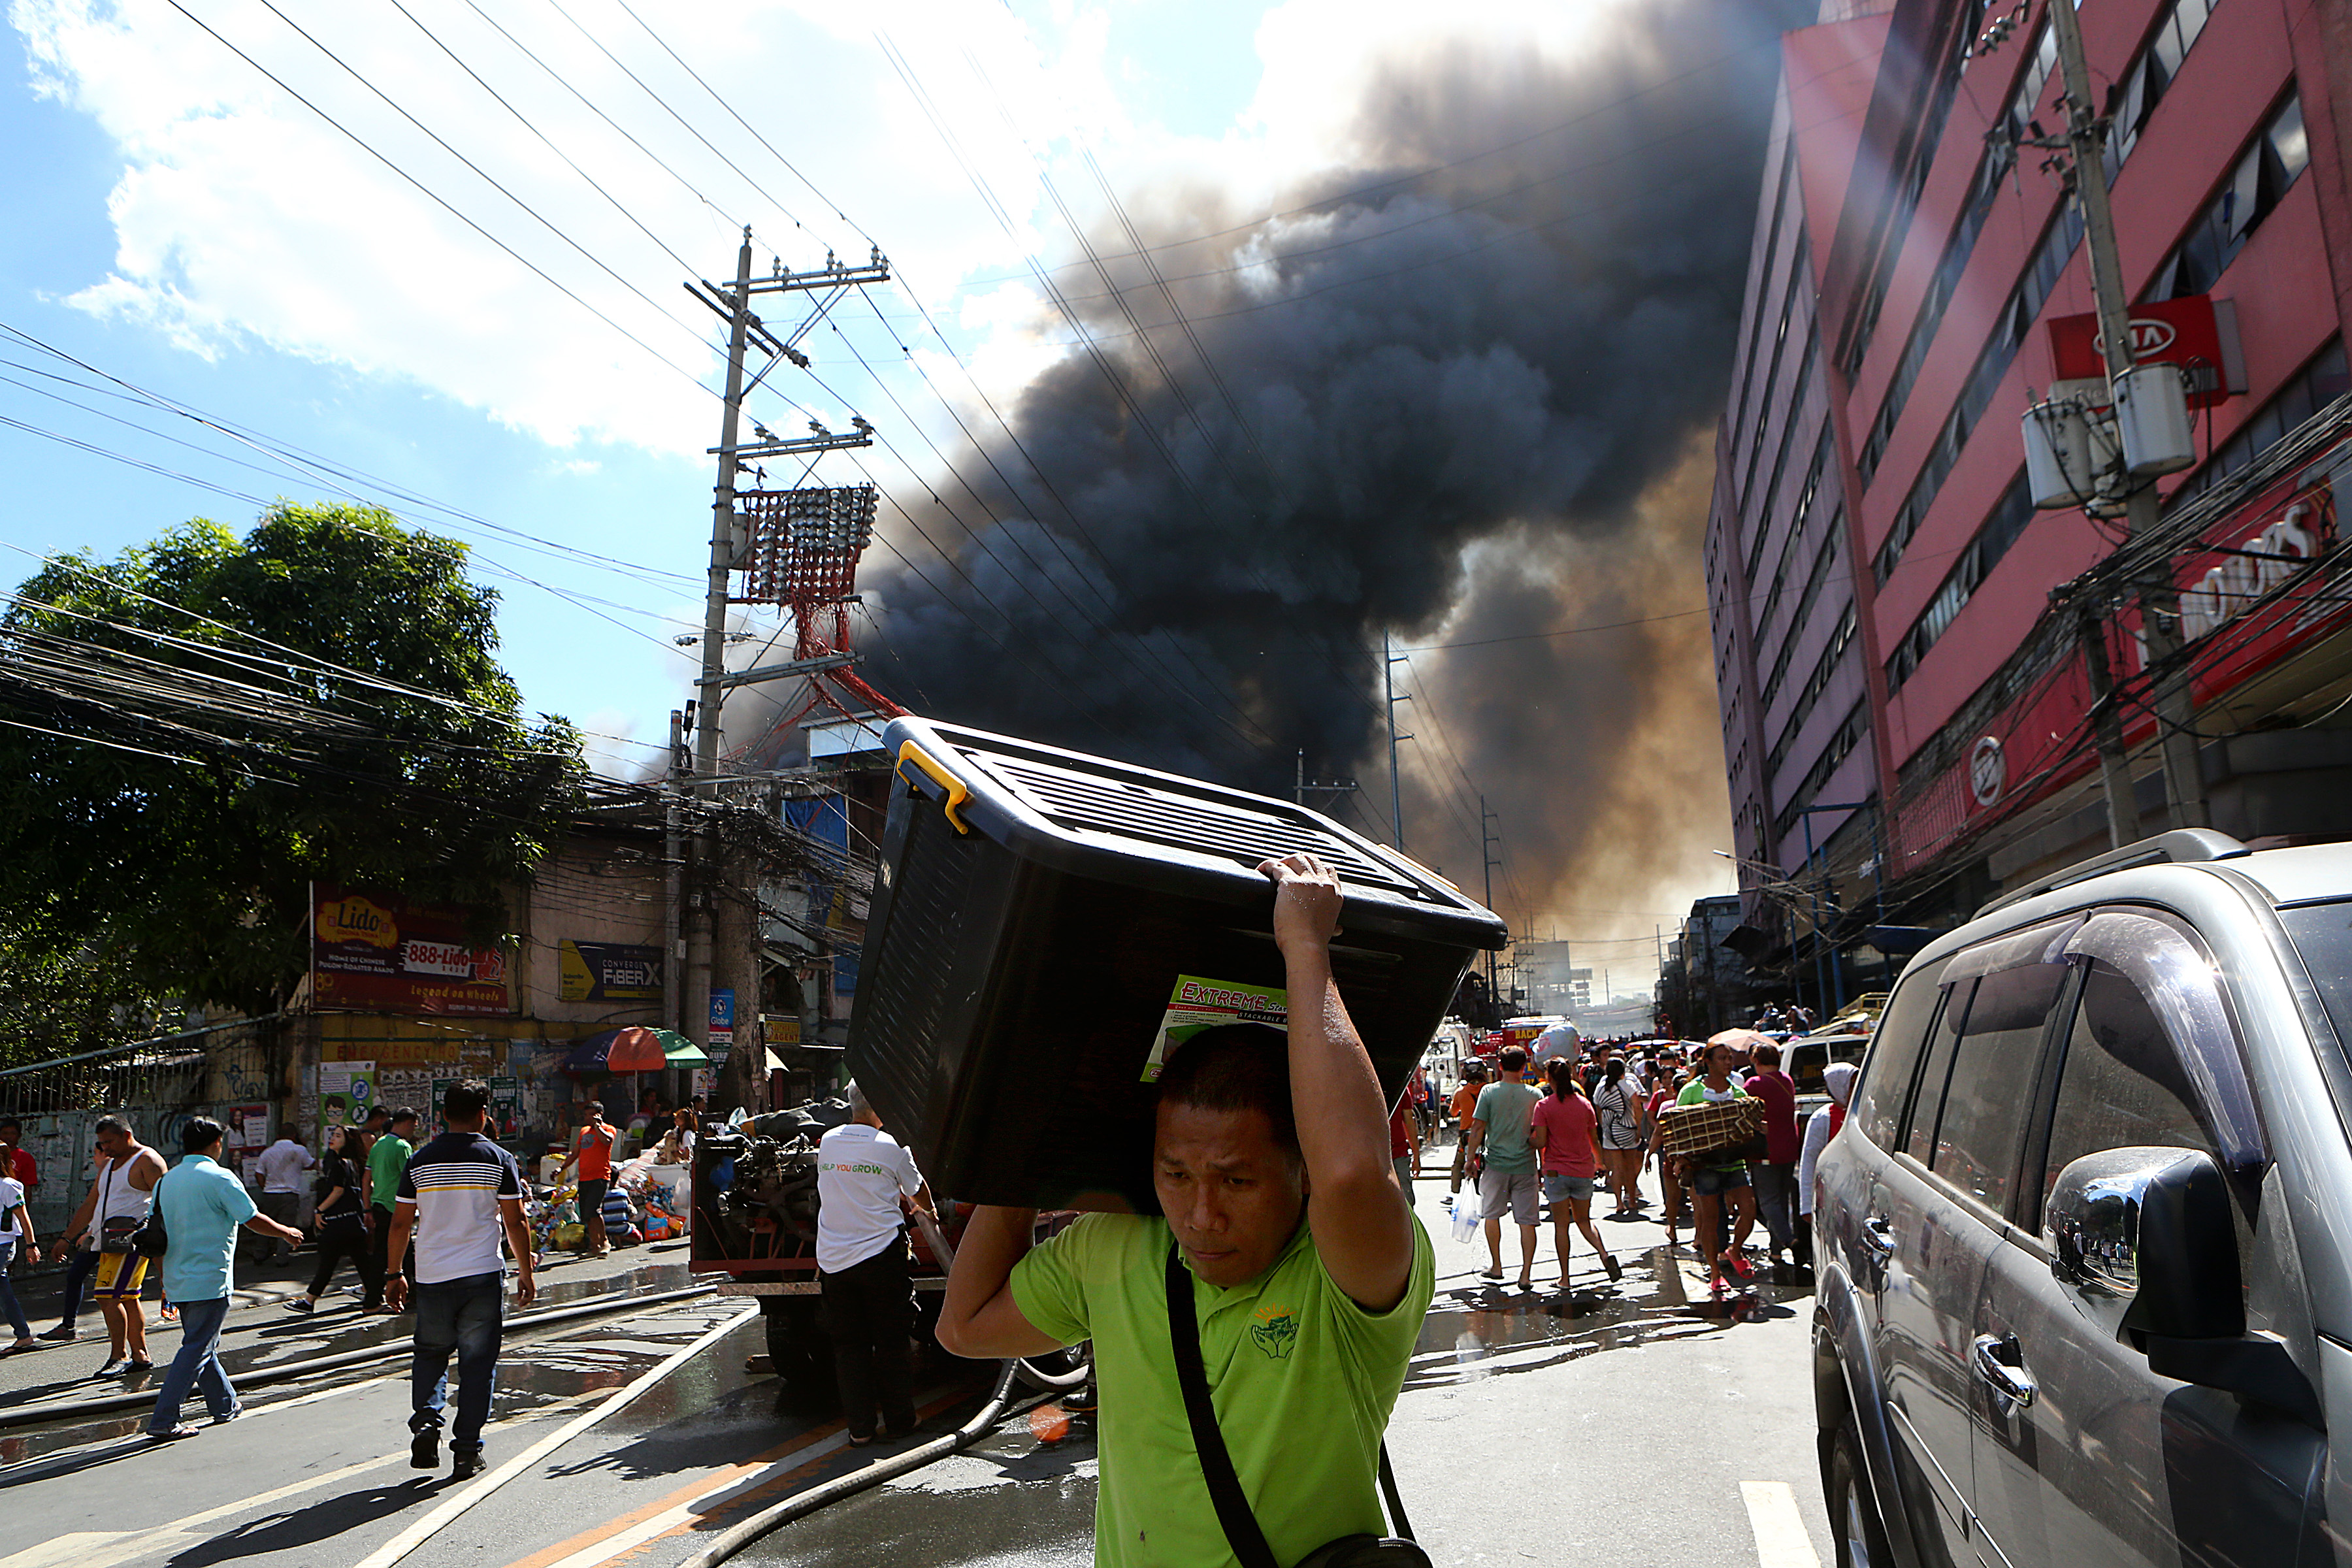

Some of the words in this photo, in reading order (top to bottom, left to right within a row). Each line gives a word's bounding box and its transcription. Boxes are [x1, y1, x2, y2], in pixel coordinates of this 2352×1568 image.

[338, 903, 380, 932] Lido
[329, 954, 348, 962] HOME
[359, 956, 385, 966] CHINESE
[408, 944, 469, 967] 888-Lido
[602, 959, 643, 970] CONVERGE
[410, 985, 449, 1001] Legend
[451, 989, 464, 998] on
[1267, 1002, 1287, 1012] Stor
[710, 1016, 729, 1025] Globe
[1238, 1012, 1281, 1022] STACKABLE
[774, 1033, 798, 1041] AGENT
[1515, 1030, 1537, 1039] BACK
[336, 1045, 431, 1060] EMERGENCY
[493, 1088, 516, 1098] BUHAY
[836, 1164, 851, 1172] YOU
[852, 1164, 882, 1175] GROW
[109, 1236, 129, 1245] FILA
